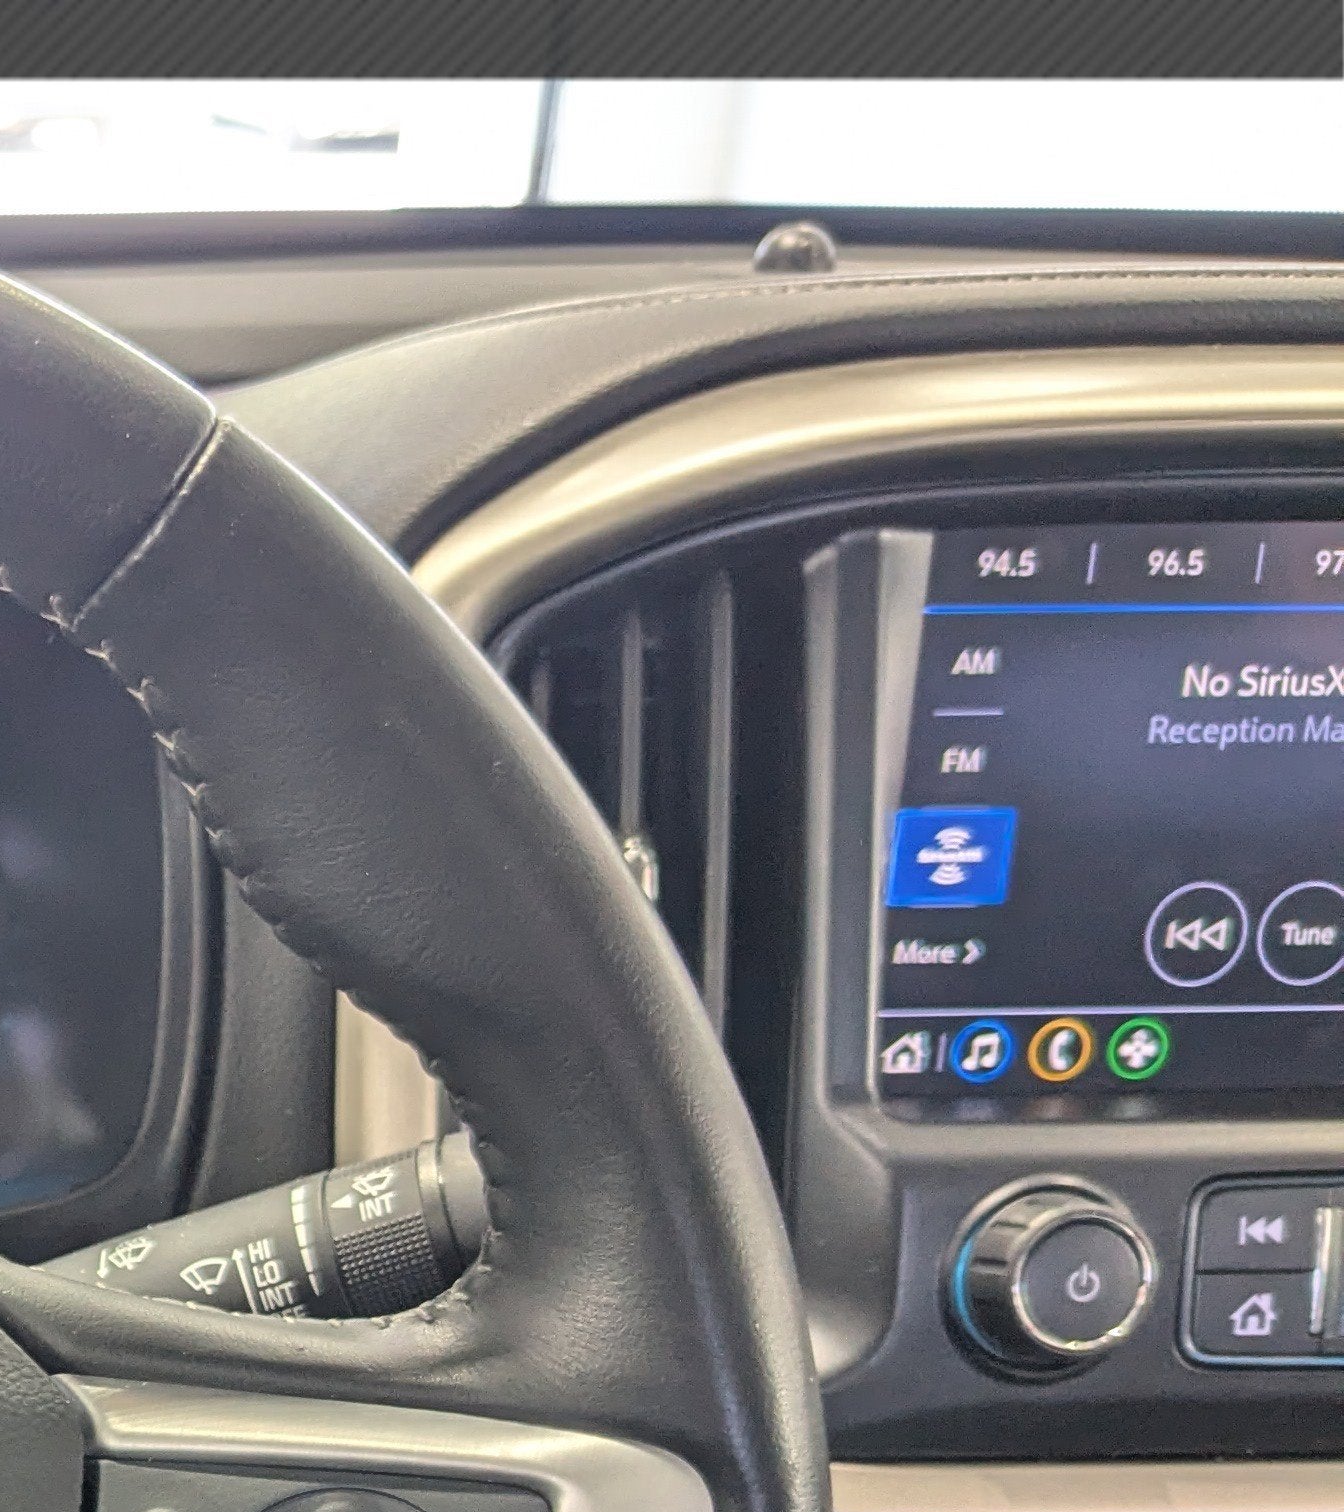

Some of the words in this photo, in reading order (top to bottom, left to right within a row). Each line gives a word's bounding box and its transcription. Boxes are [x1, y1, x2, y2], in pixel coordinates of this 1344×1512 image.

[978, 549, 1037, 577] 94.5
[1148, 549, 1204, 576] 96.5
[951, 649, 997, 675] AM
[1181, 664, 1229, 698] No
[1148, 715, 1295, 750] Reception
[941, 748, 984, 773] FM
[1281, 921, 1335, 946] Tune
[892, 939, 956, 964] More
[359, 1194, 395, 1221] INT
[248, 1239, 271, 1263] HI
[253, 1261, 282, 1288] LO
[259, 1280, 298, 1312] INT
